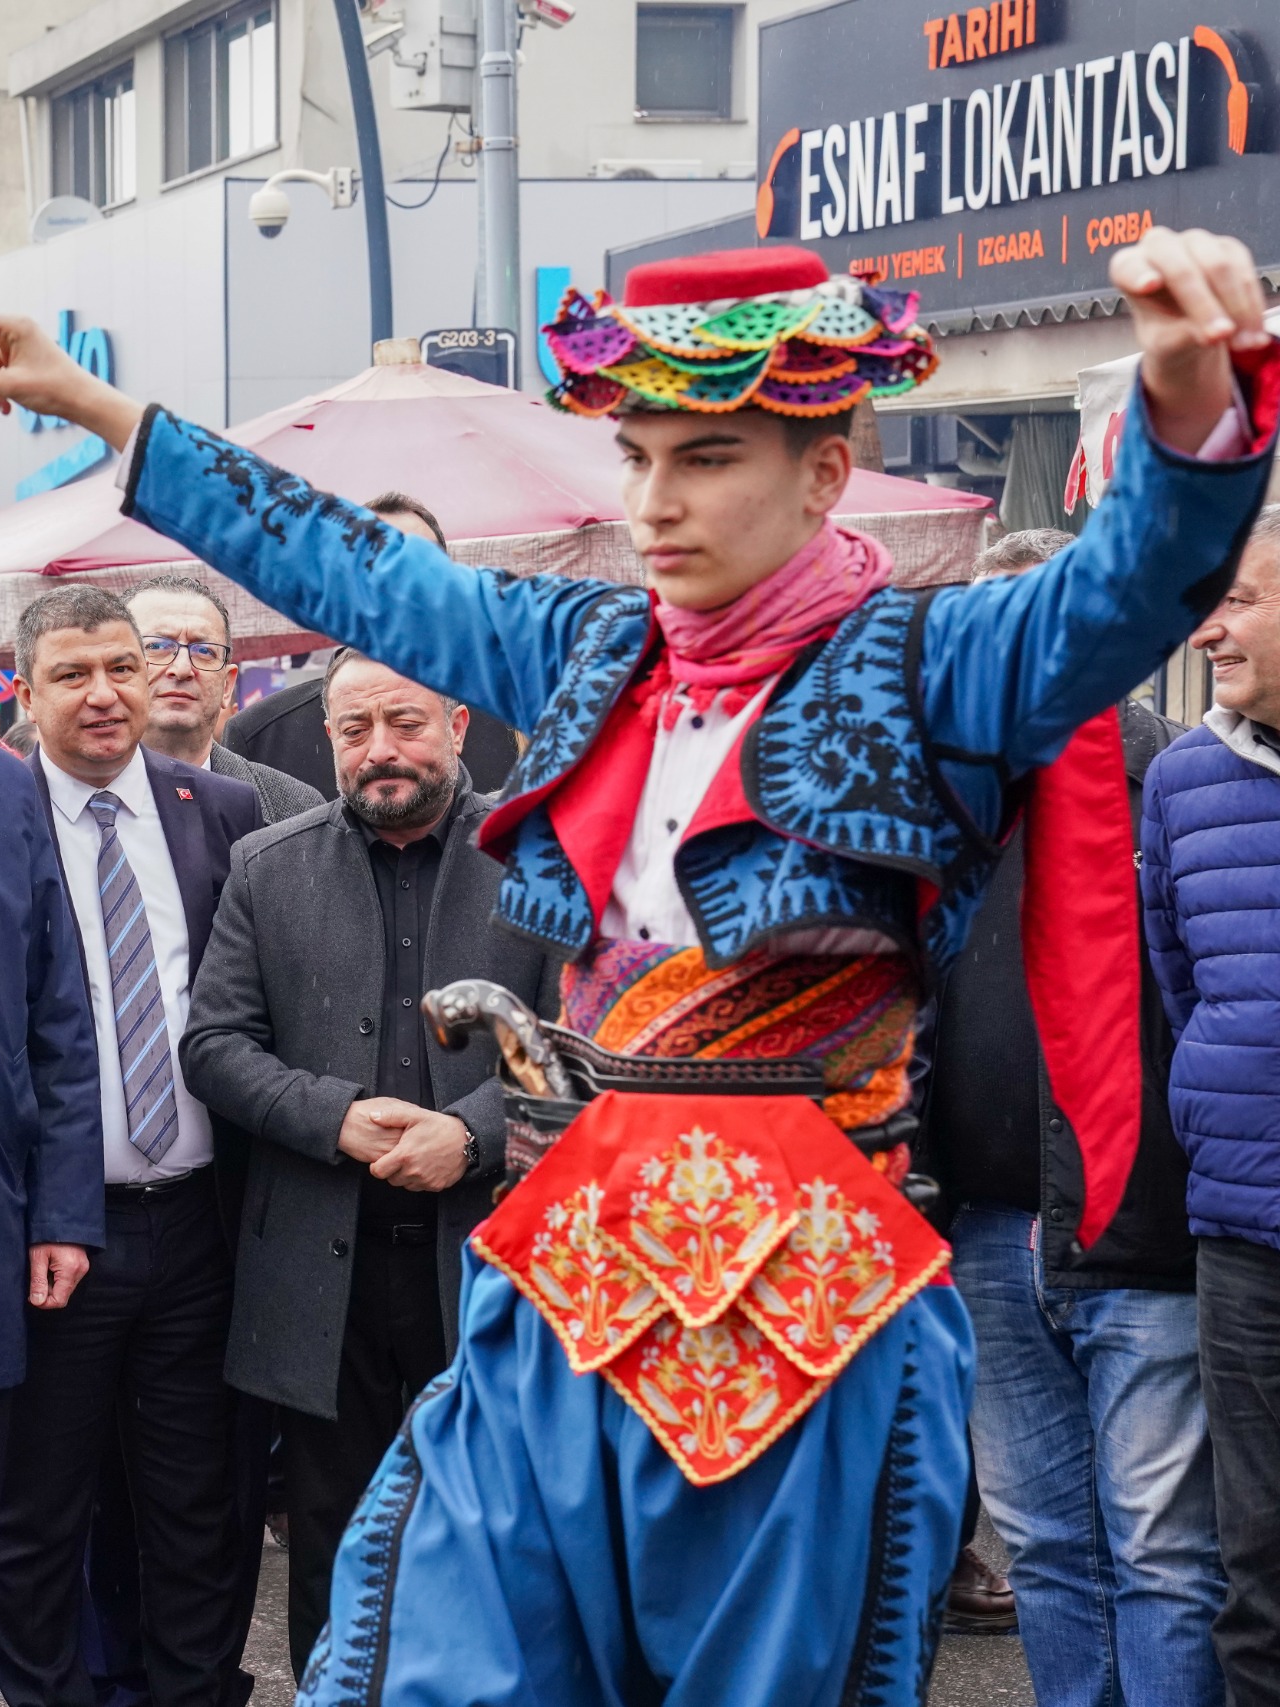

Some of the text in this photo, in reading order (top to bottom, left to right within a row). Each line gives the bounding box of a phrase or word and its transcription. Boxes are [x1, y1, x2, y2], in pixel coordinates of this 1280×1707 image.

[800, 36, 1190, 240] ESNAF LOKANTASI
[892, 245, 946, 279] YEMEK
[978, 229, 1045, 266] IZGARA
[1086, 209, 1154, 254] ÇORBA
[437, 329, 496, 348] G203-3
